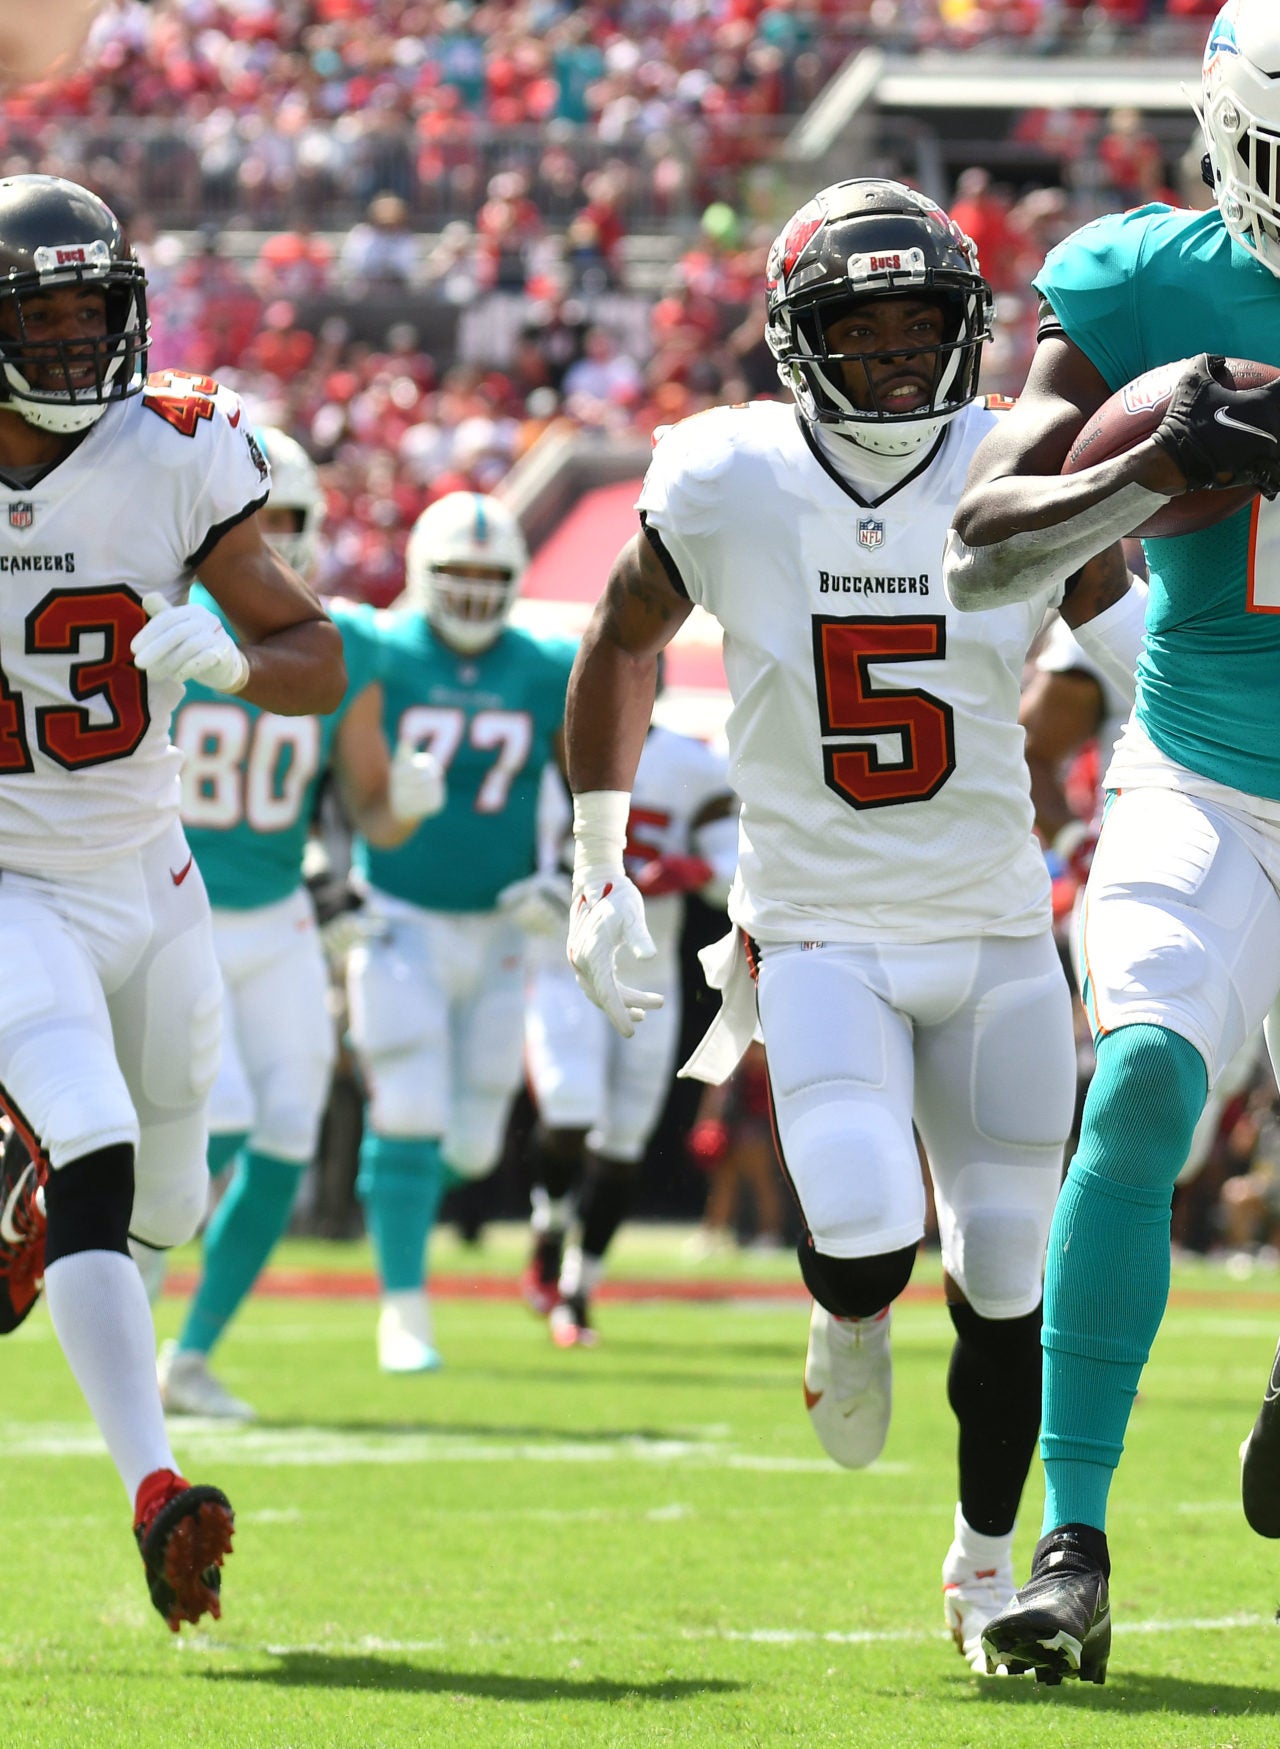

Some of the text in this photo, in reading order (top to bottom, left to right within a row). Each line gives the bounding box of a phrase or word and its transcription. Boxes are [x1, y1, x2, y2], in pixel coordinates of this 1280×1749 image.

[870, 254, 901, 271] BUCS
[818, 570, 930, 598] BUCCANEERS
[861, 529, 881, 544] NFL
[0, 583, 152, 776] 3
[811, 613, 957, 811] 5
[175, 702, 320, 833] 80
[400, 705, 532, 814] 77
